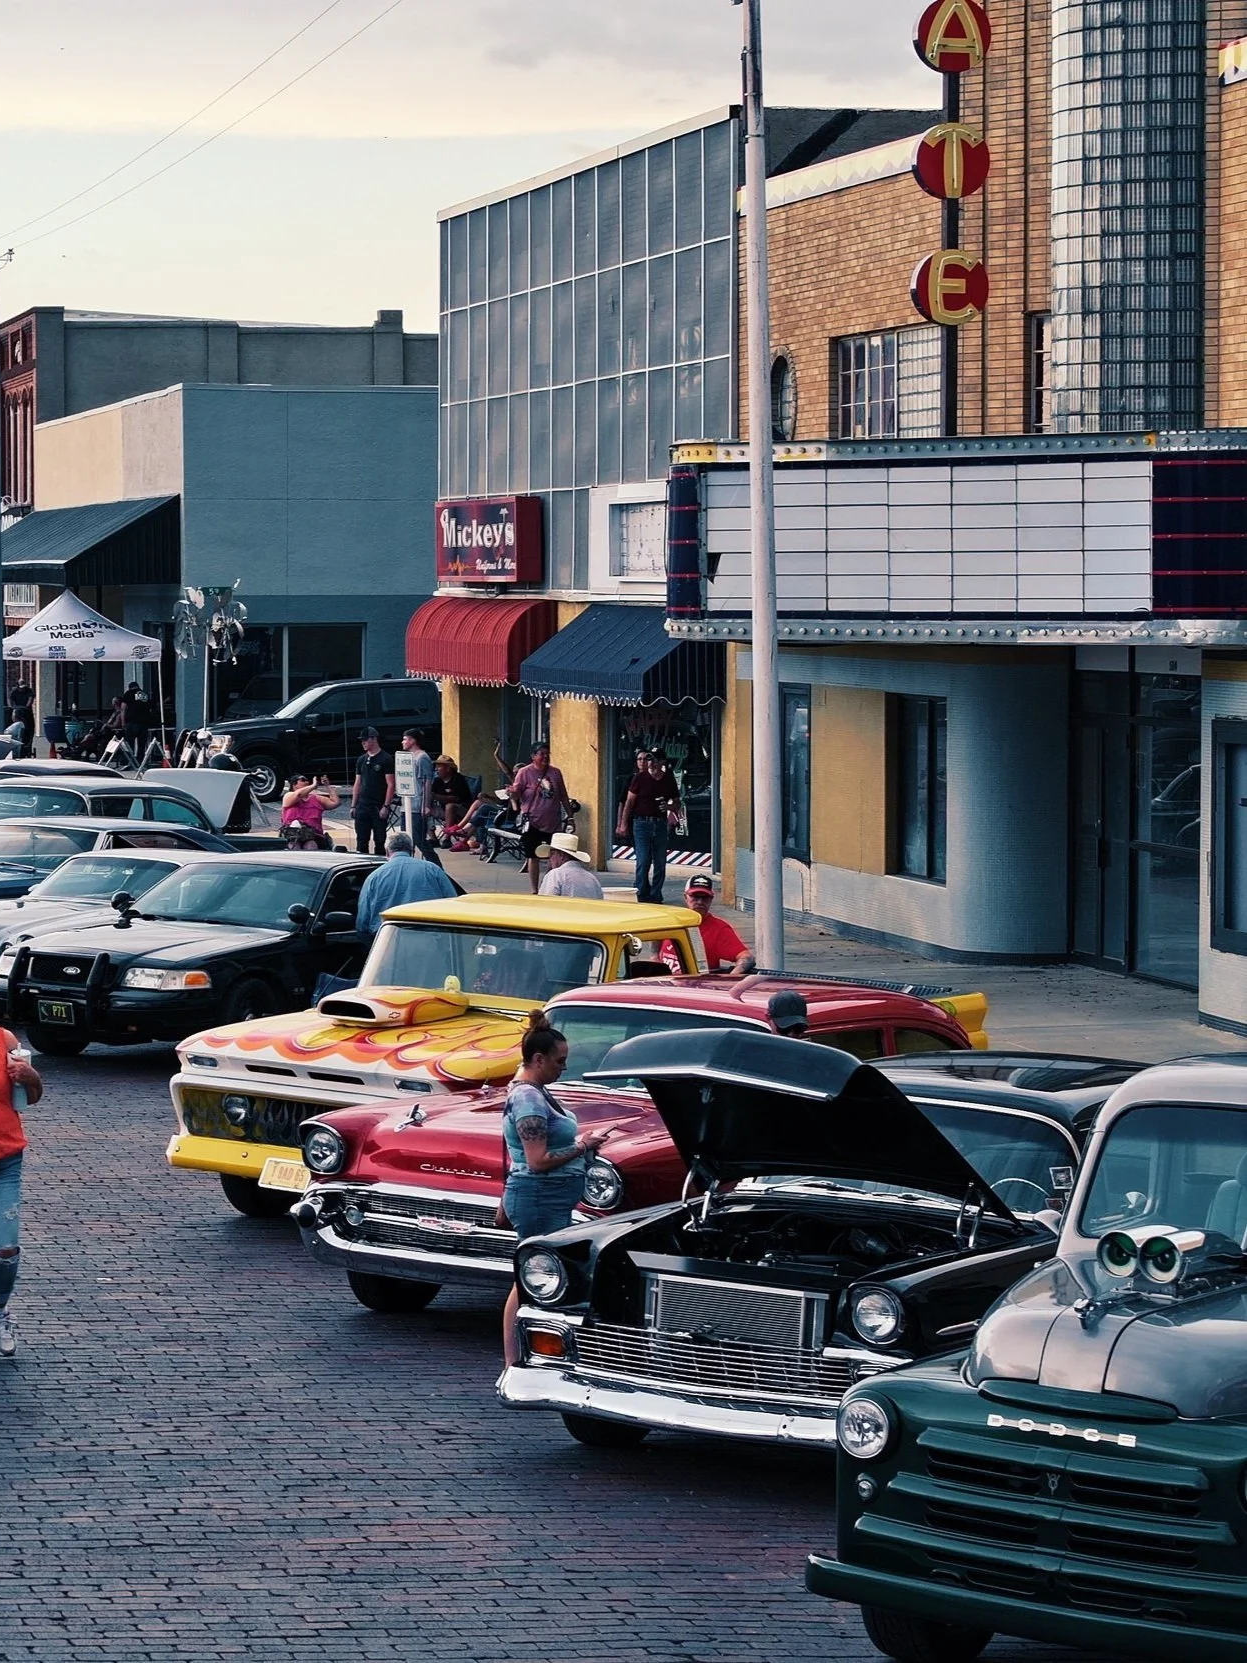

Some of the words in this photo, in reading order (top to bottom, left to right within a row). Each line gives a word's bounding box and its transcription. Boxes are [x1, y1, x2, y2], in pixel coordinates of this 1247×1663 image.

[440, 507, 515, 549] Mickey's
[49, 631, 95, 639] Media
[52, 1005, 67, 1018] P71
[987, 1413, 1137, 1448] DODGE
